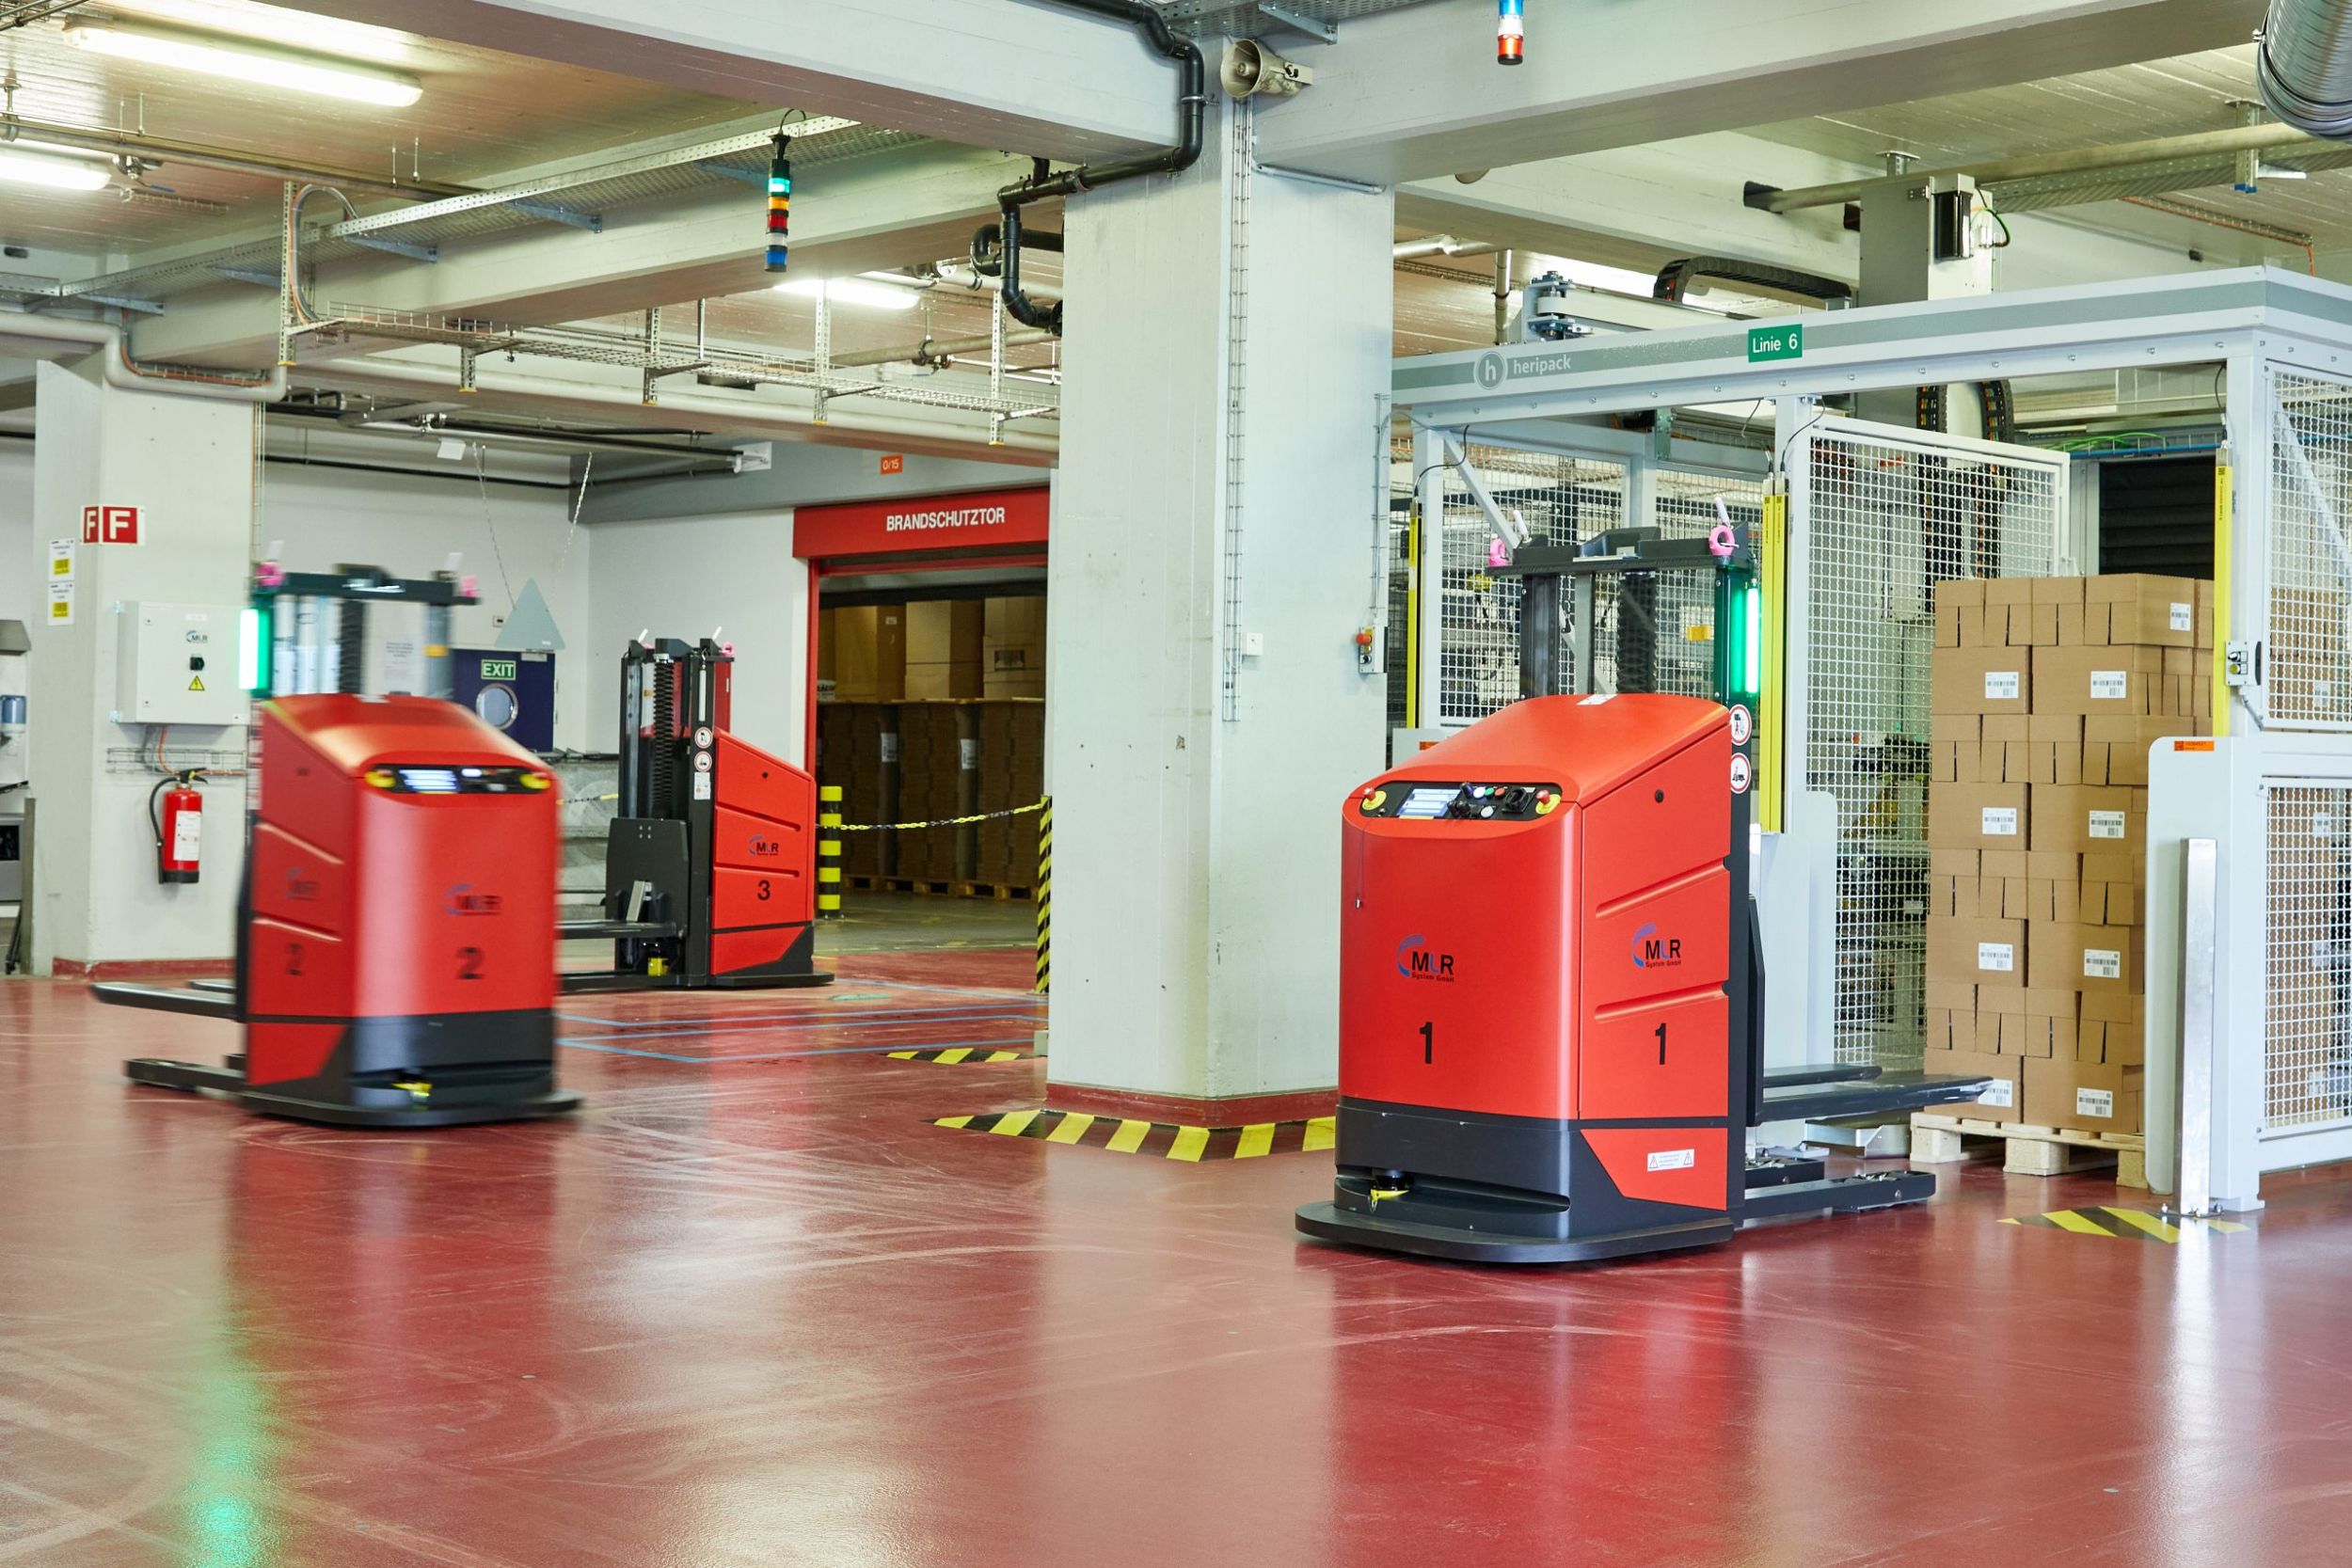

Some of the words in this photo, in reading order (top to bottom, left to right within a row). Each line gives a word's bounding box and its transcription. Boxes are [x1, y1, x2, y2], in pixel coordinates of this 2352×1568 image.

[1753, 336, 1782, 354] Linie
[1788, 333, 1798, 350] 6
[1513, 354, 1571, 375] heripack
[882, 459, 899, 470] 0/15
[86, 510, 97, 540] F
[109, 510, 131, 540] F
[886, 507, 1006, 531] BRANDSCHUTZTOR
[483, 663, 515, 677] EXIT
[756, 842, 779, 852] MLR
[757, 879, 771, 901] 3
[286, 942, 305, 976] 2
[1645, 939, 1681, 959] MLR
[456, 946, 485, 980] 2
[1411, 951, 1454, 975] MLR
[1411, 972, 1434, 980] System
[1419, 1022, 1433, 1065] 1
[1655, 1022, 1667, 1066] 1
